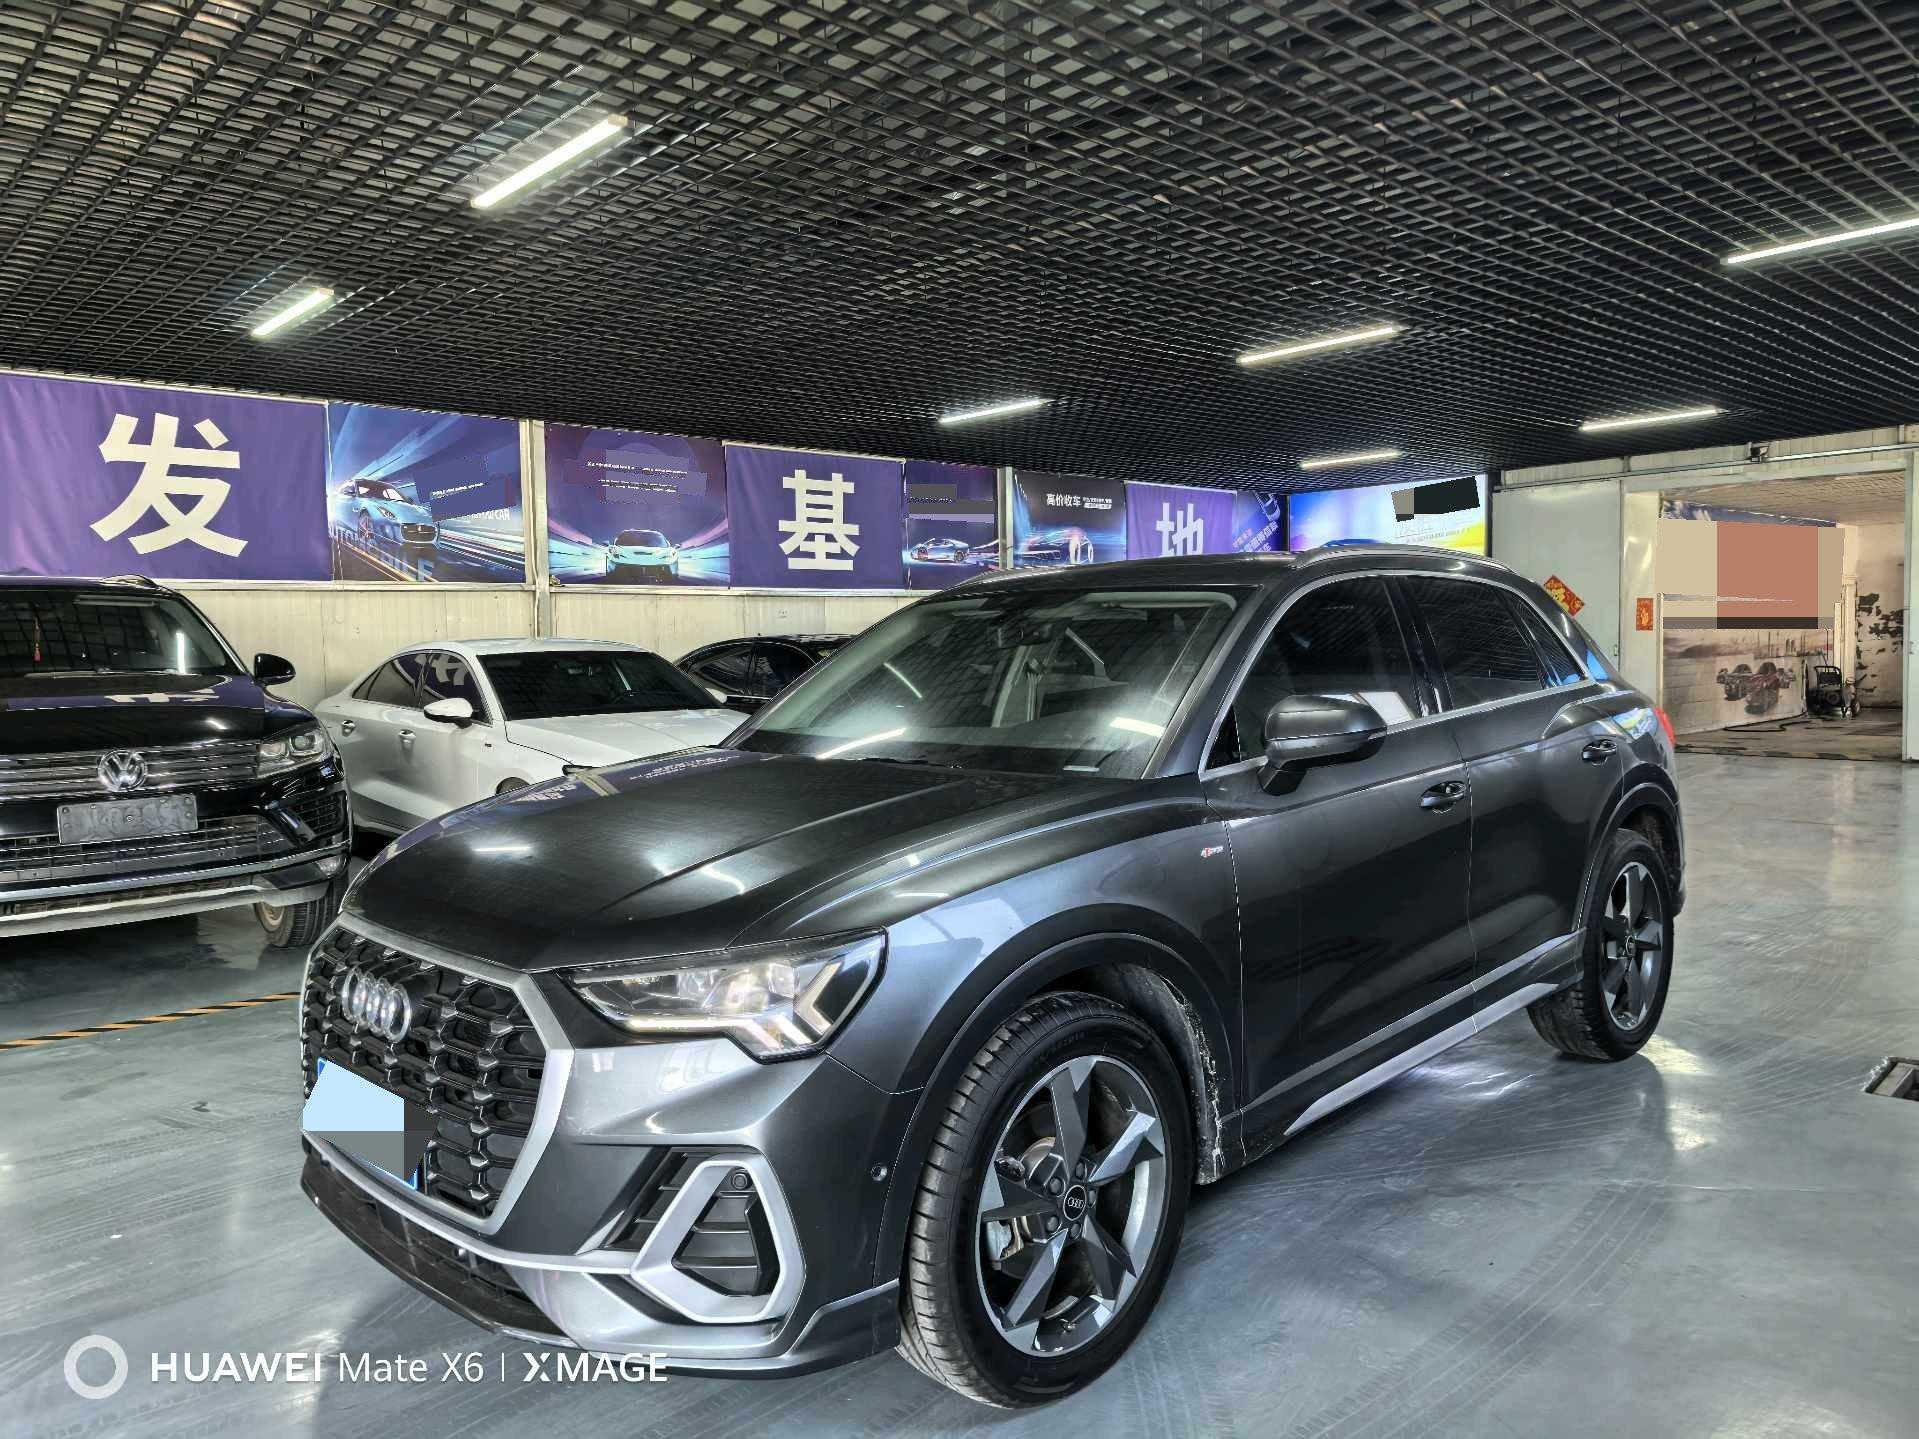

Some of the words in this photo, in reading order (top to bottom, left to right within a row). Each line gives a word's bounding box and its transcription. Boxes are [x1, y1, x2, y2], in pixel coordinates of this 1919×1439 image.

[90, 412, 248, 557] 发
[778, 469, 860, 571] 基
[1046, 493, 1081, 507] 高价收车
[1156, 502, 1204, 557] 地
